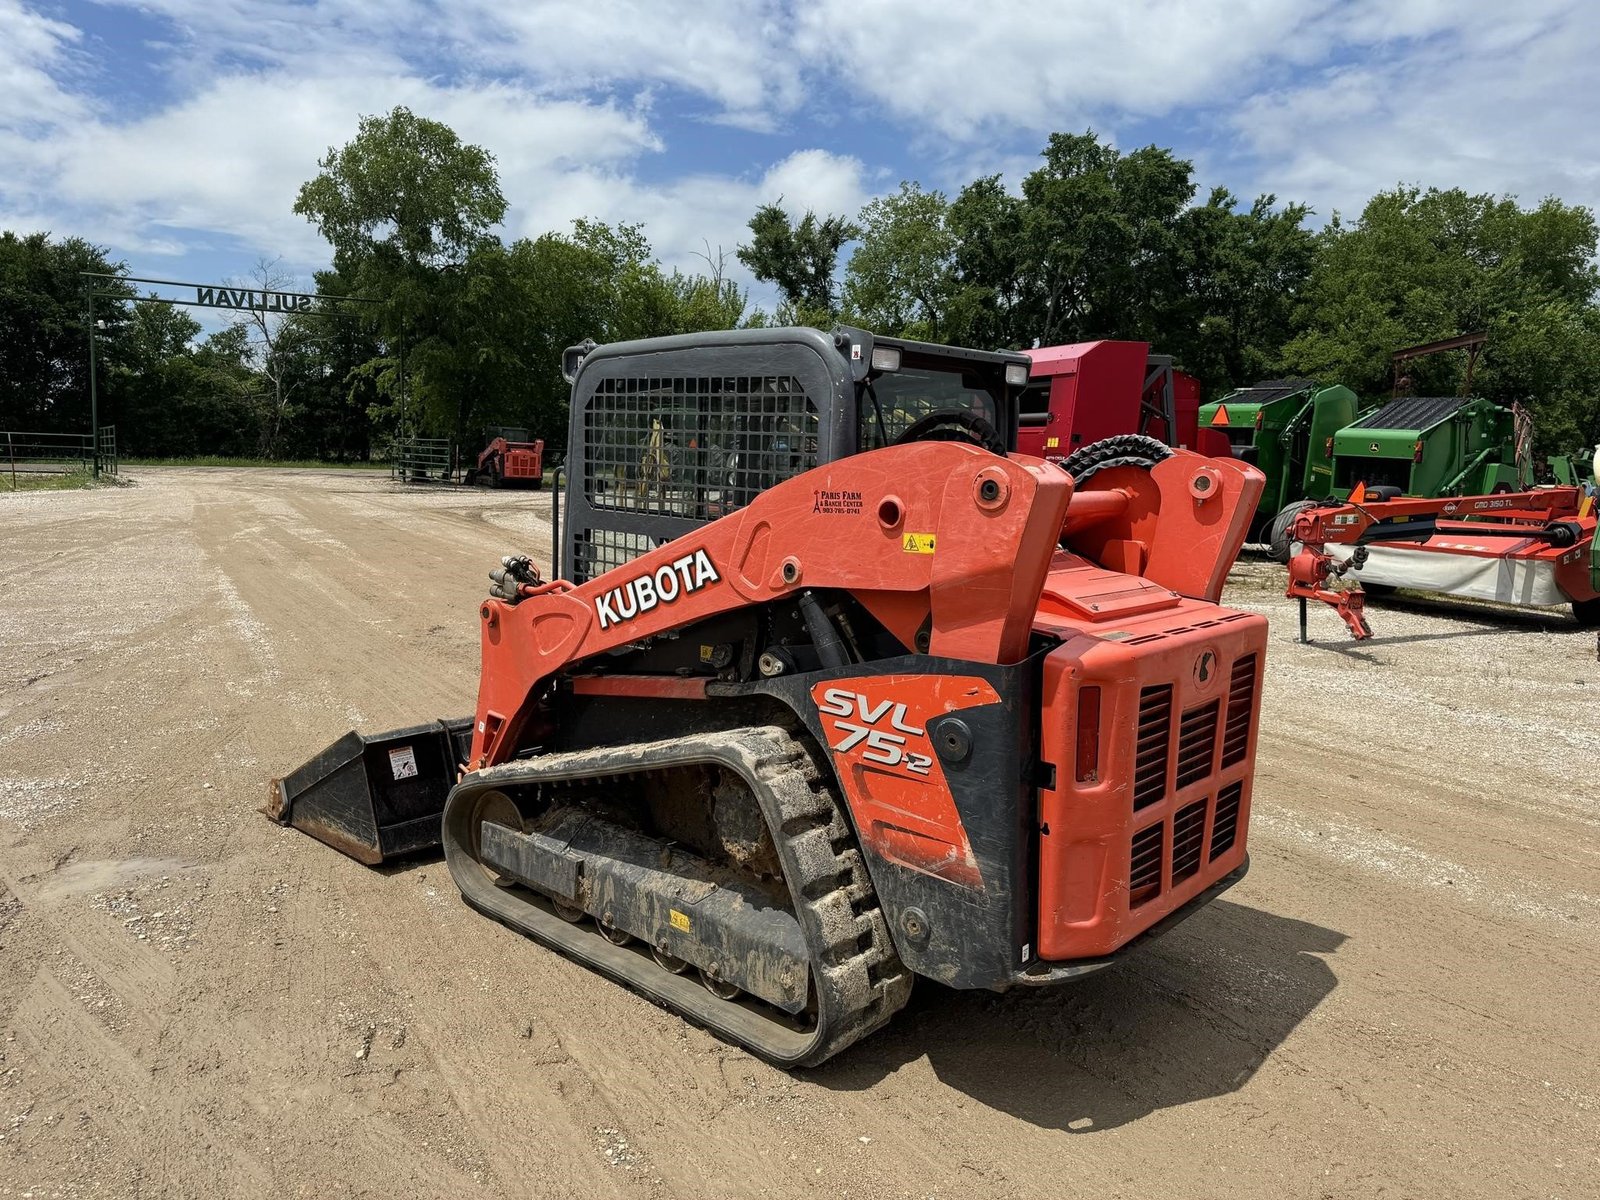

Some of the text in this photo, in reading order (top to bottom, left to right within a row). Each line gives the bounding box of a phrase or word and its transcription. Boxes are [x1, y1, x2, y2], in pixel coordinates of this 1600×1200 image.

[821, 491, 861, 500] PARIS FARM
[594, 549, 720, 629] KUBOTA
[819, 688, 924, 735] SVL
